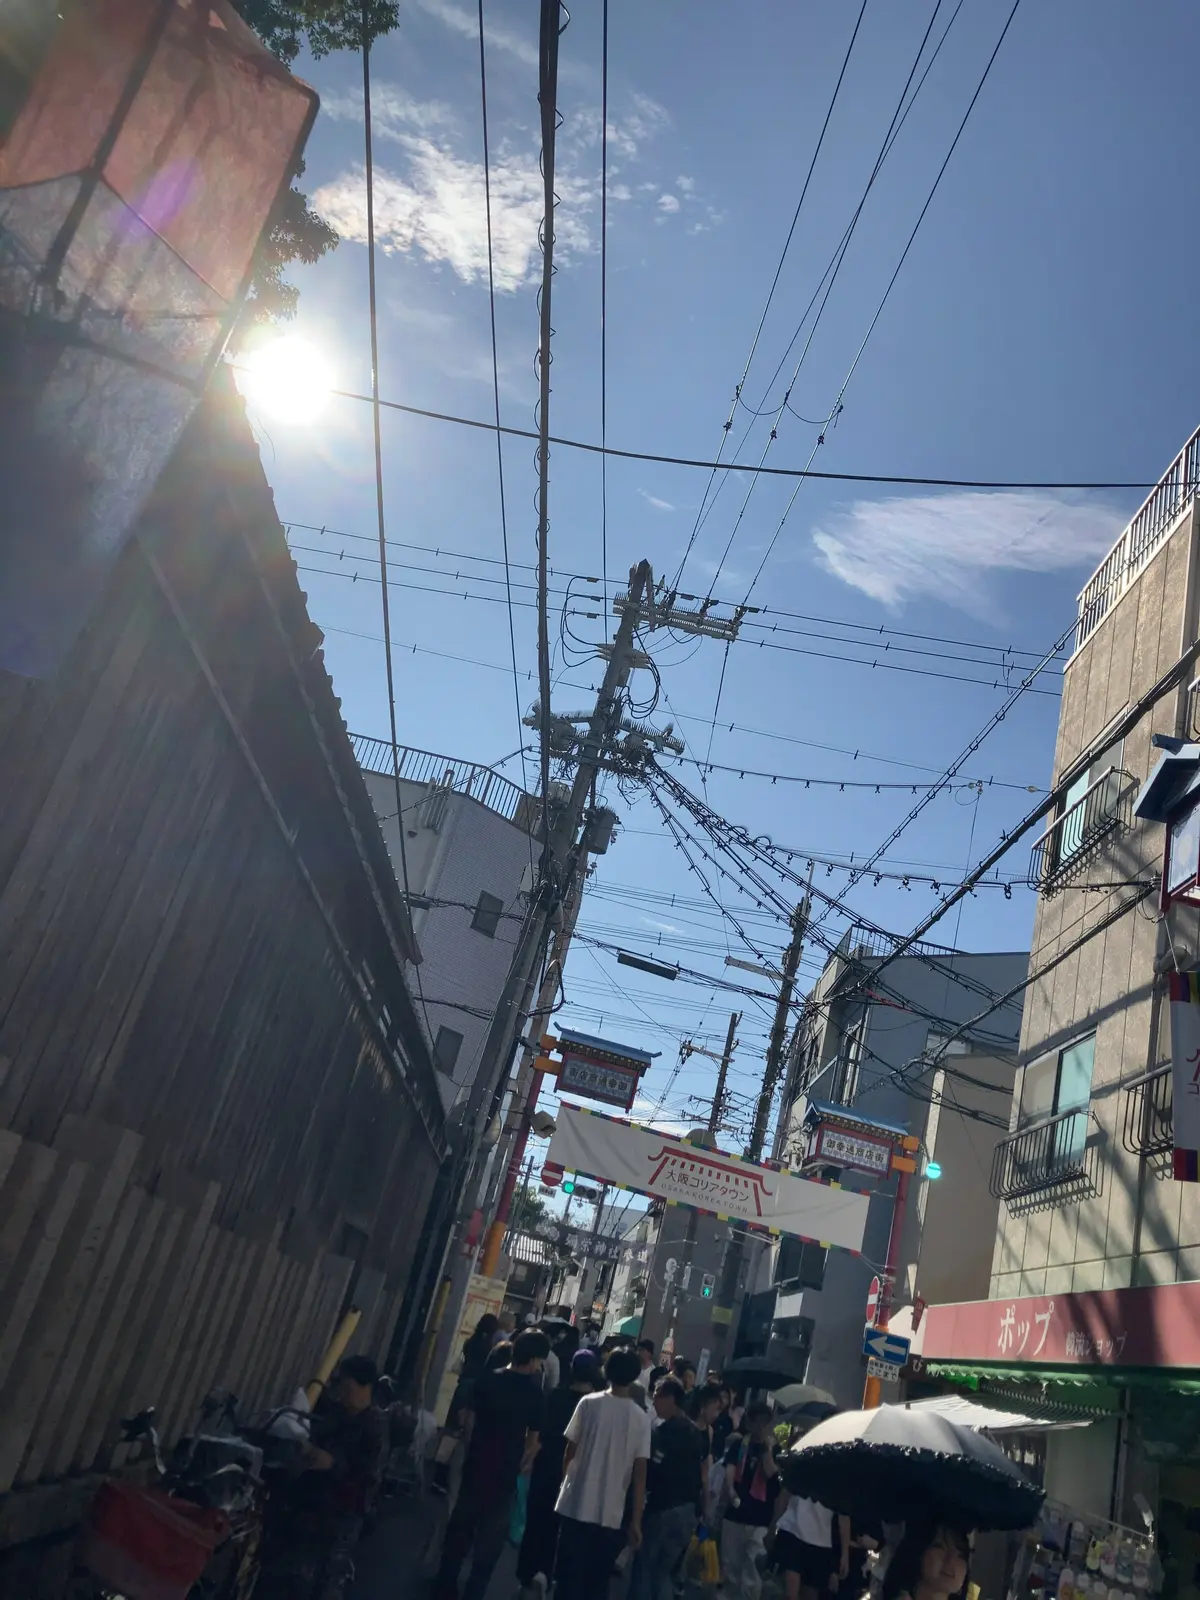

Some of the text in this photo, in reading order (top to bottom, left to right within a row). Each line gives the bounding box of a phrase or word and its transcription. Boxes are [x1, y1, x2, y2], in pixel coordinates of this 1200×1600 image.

[661, 1183, 748, 1213] OSAKA KOREA TOWN
[665, 1169, 749, 1202] 大阪コリアタウン
[997, 1300, 1055, 1356] ポップ
